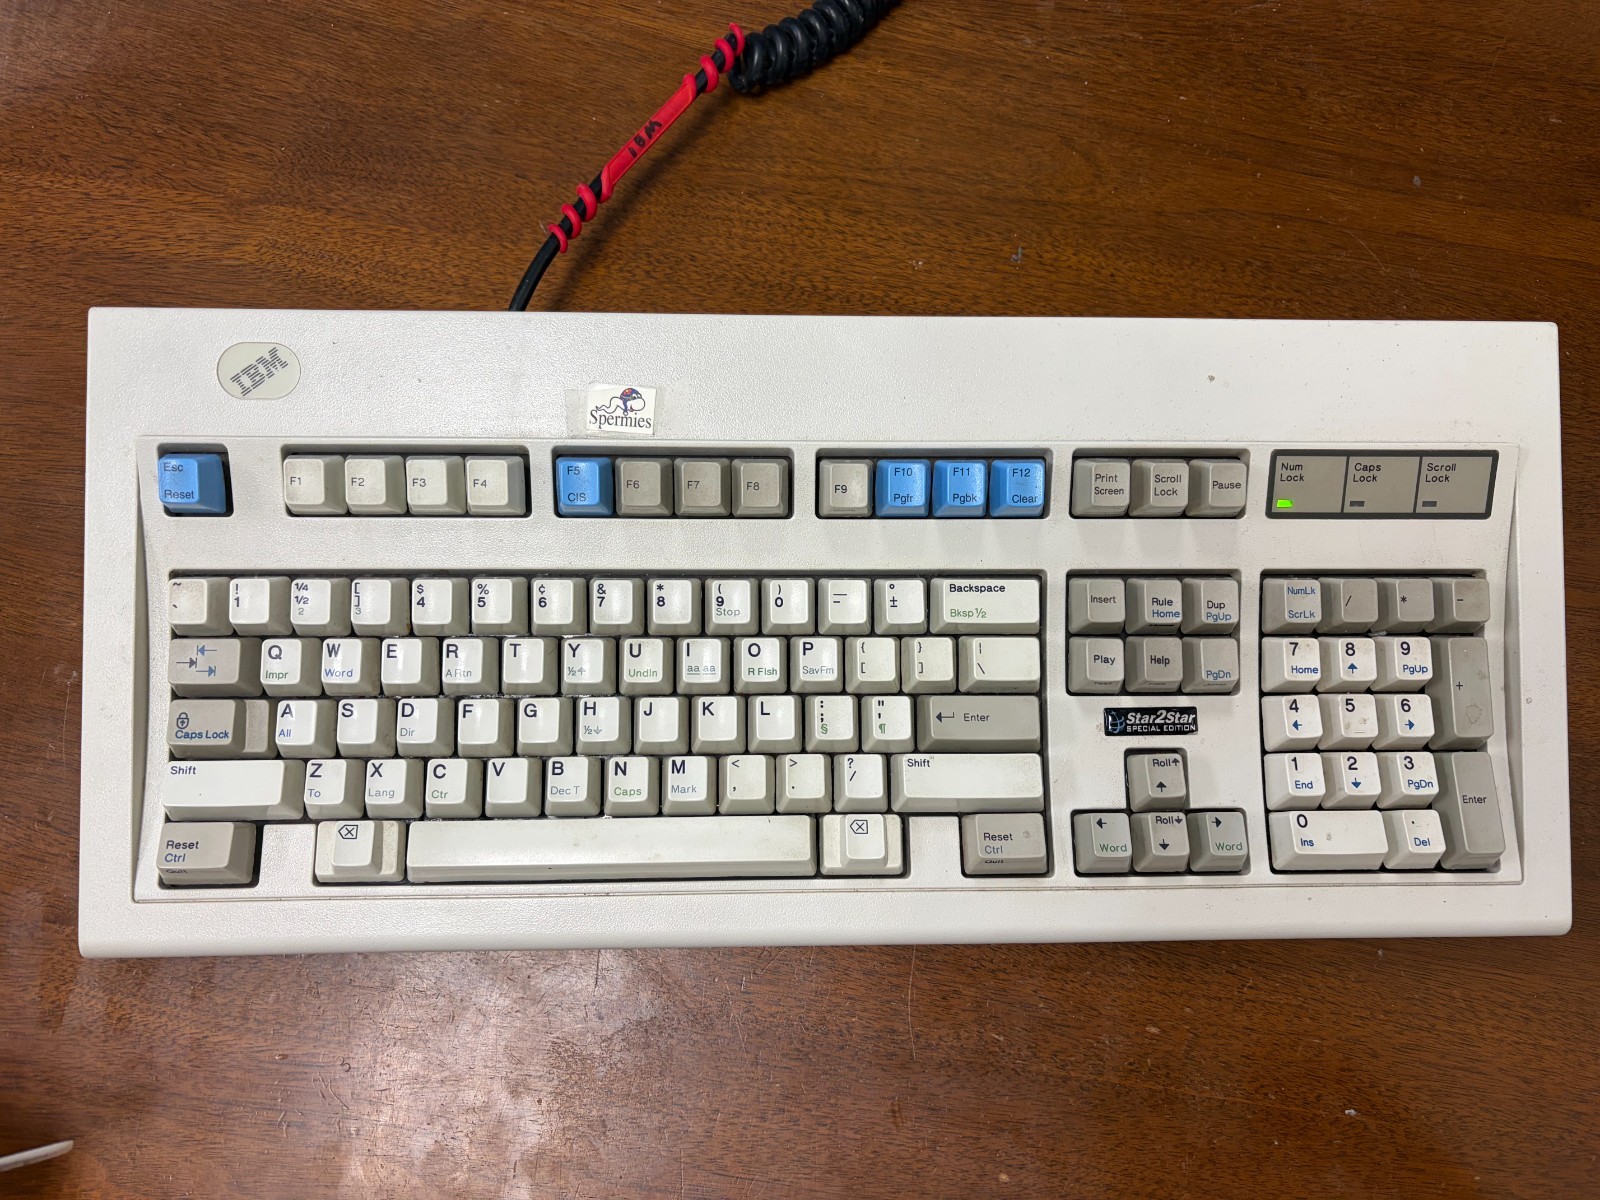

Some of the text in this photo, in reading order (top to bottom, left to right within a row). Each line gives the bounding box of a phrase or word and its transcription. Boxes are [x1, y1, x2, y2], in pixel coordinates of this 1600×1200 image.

[628, 121, 662, 159] IBM
[230, 347, 288, 396] IBM
[589, 410, 652, 429] Spermies
[164, 462, 183, 471] Esc
[567, 466, 580, 475] F5
[1281, 463, 1303, 471] Num
[1354, 463, 1381, 473] Caps
[1427, 463, 1456, 471] Scroll
[895, 468, 912, 477] F10
[953, 468, 970, 476] F11
[1012, 469, 1030, 477] F12
[352, 478, 364, 486] F2
[413, 479, 426, 487] F3
[1095, 474, 1118, 482] Print
[1280, 474, 1304, 482] Lock
[1353, 474, 1377, 482] Lock
[1426, 474, 1450, 482] Lock
[627, 480, 640, 489] F6
[688, 481, 700, 489] F7
[747, 482, 760, 490] F8
[834, 485, 847, 494] F9
[1213, 481, 1241, 489] Pause
[164, 490, 194, 499] Reset
[894, 494, 912, 505] Pgfr
[953, 494, 976, 505] Pgbk
[1012, 495, 1038, 503] Clear
[416, 584, 424, 594] $
[478, 584, 489, 594] %
[597, 584, 606, 594] &
[949, 584, 1005, 594] Backspace
[1287, 587, 1315, 595] NumLk
[234, 597, 240, 607] 1
[416, 597, 426, 607] 4
[477, 597, 486, 608] 5
[539, 597, 547, 608] 6
[597, 597, 605, 607] 7
[656, 597, 665, 607] 8
[716, 597, 724, 607] 9
[775, 597, 784, 608] 0
[1090, 595, 1116, 603] Insert
[1152, 598, 1173, 606] Rule
[1346, 596, 1352, 606] /
[1207, 601, 1225, 610] Dup
[716, 608, 740, 617] Stop
[950, 609, 973, 619] Bksp
[1206, 612, 1232, 622] PgUp
[1288, 610, 1315, 618] ScrLk
[268, 645, 282, 660] Q
[326, 644, 340, 658] W
[387, 644, 397, 658] E
[446, 644, 458, 658] R
[509, 644, 521, 658] T
[568, 644, 581, 658] Y
[630, 644, 641, 658] U
[686, 643, 690, 656] I
[748, 643, 761, 657] O
[803, 642, 813, 656] P
[1289, 642, 1298, 656] 7
[1346, 642, 1355, 656] 8
[1400, 642, 1410, 655] 9
[1094, 655, 1116, 665] Play
[1150, 656, 1170, 667] Help
[325, 669, 353, 678] Word
[1402, 665, 1428, 674] PgUp
[265, 670, 288, 680] Impr
[1206, 671, 1231, 680] PgDn
[341, 703, 354, 717] S
[402, 703, 415, 717] D
[524, 703, 537, 717] G
[583, 701, 596, 715] H
[644, 702, 652, 716] J
[702, 702, 714, 716] K
[761, 702, 770, 715] L
[1289, 699, 1299, 712] 4
[1346, 699, 1355, 712] 5
[1401, 698, 1411, 712] 6
[281, 704, 293, 717] A
[463, 704, 473, 718] F
[964, 713, 989, 722] Enter
[1126, 710, 1196, 724] Star2Star
[175, 730, 229, 740] Caps Lock
[279, 729, 291, 737] All
[401, 728, 415, 737] Dir
[672, 760, 685, 774] M
[847, 758, 853, 768] ?
[907, 759, 930, 767] Shift
[1291, 757, 1298, 770] 1
[1347, 757, 1358, 770] 2
[1404, 756, 1414, 769] 3
[170, 766, 196, 775] Shift
[310, 763, 323, 778] Z
[370, 763, 383, 777] X
[433, 764, 446, 779] C
[492, 762, 505, 776] V
[552, 762, 564, 775] B
[614, 761, 627, 776] N
[850, 771, 856, 781] /
[671, 785, 696, 793] Mark
[1295, 781, 1313, 789] End
[1408, 780, 1433, 790] PgDn
[308, 789, 321, 798] To
[369, 788, 394, 798] Lang
[432, 790, 448, 799] Ctr
[550, 786, 580, 795] Dec T
[614, 787, 642, 796] Caps
[166, 840, 199, 849] Reset
[1216, 842, 1242, 850] Word
[1301, 838, 1314, 846] Ins
[1414, 838, 1430, 846] Del
[985, 845, 1003, 854] Ctrl
[1100, 844, 1127, 852] Word
[165, 853, 185, 862] Ctrl
